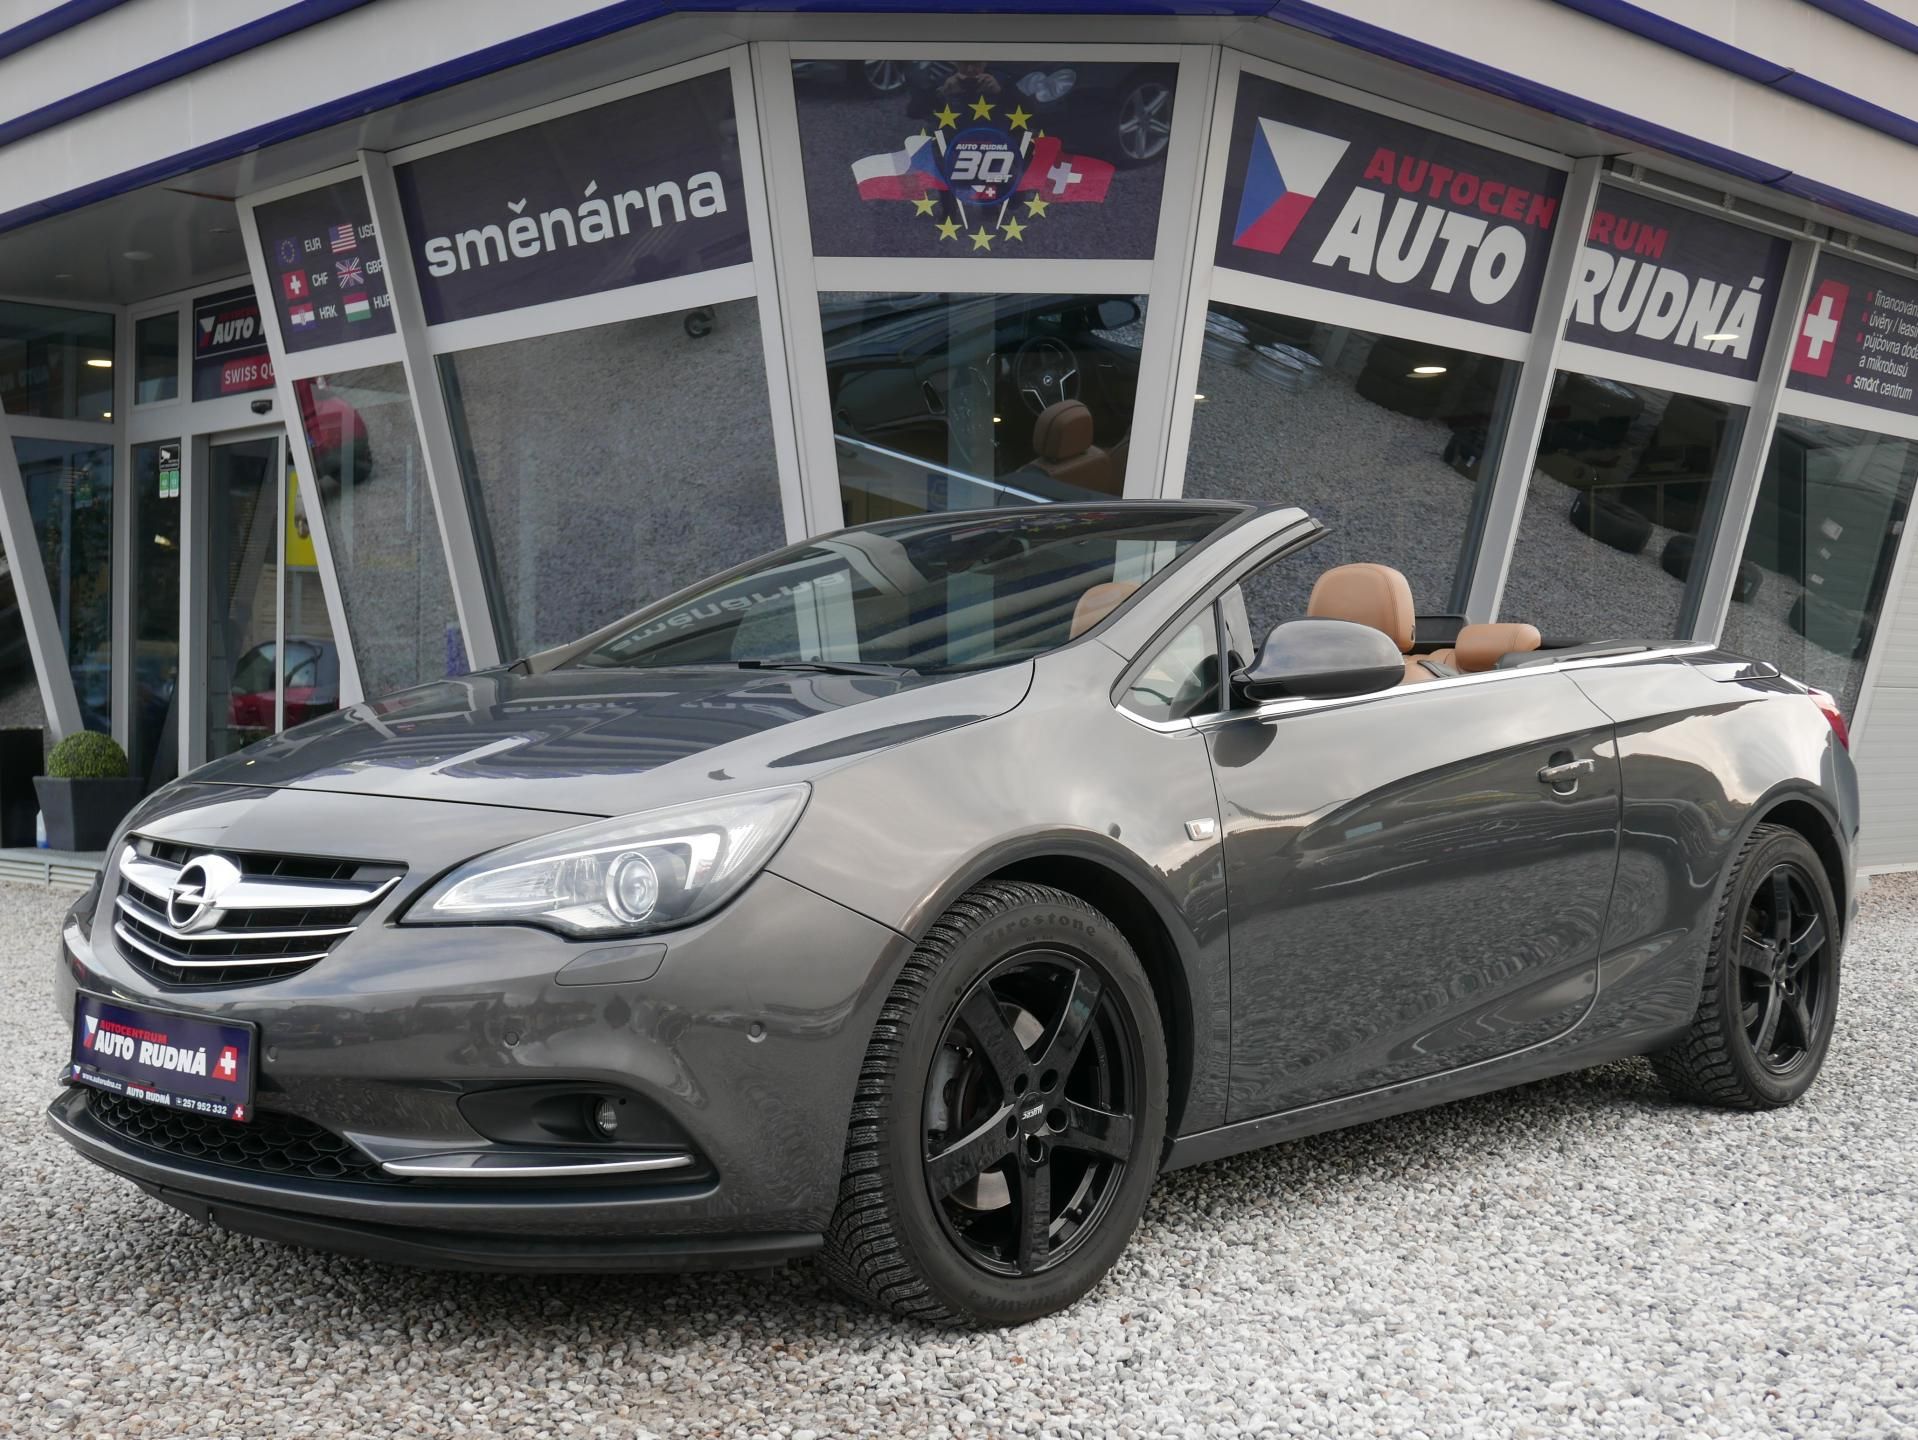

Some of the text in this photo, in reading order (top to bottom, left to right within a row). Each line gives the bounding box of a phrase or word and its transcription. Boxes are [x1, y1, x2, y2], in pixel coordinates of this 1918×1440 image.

[950, 151, 1015, 181] 30
[424, 170, 728, 278] směnárna
[304, 237, 322, 253] EUR
[312, 272, 329, 287] CHF
[1312, 186, 1765, 361] AUTO RUDNÁ
[319, 304, 338, 320] HRK
[212, 316, 254, 345] AUTO
[1859, 355, 1867, 367] a
[225, 365, 257, 385] SWISS
[1880, 382, 1913, 401] centrum
[99, 1019, 168, 1045] AUTOCENTRUM
[94, 1029, 207, 1076] AUTO RUDNÁ
[126, 1086, 144, 1099] AUTO
[145, 1091, 171, 1106] RUDNÁ
[182, 1098, 228, 1115] 257 952 332
